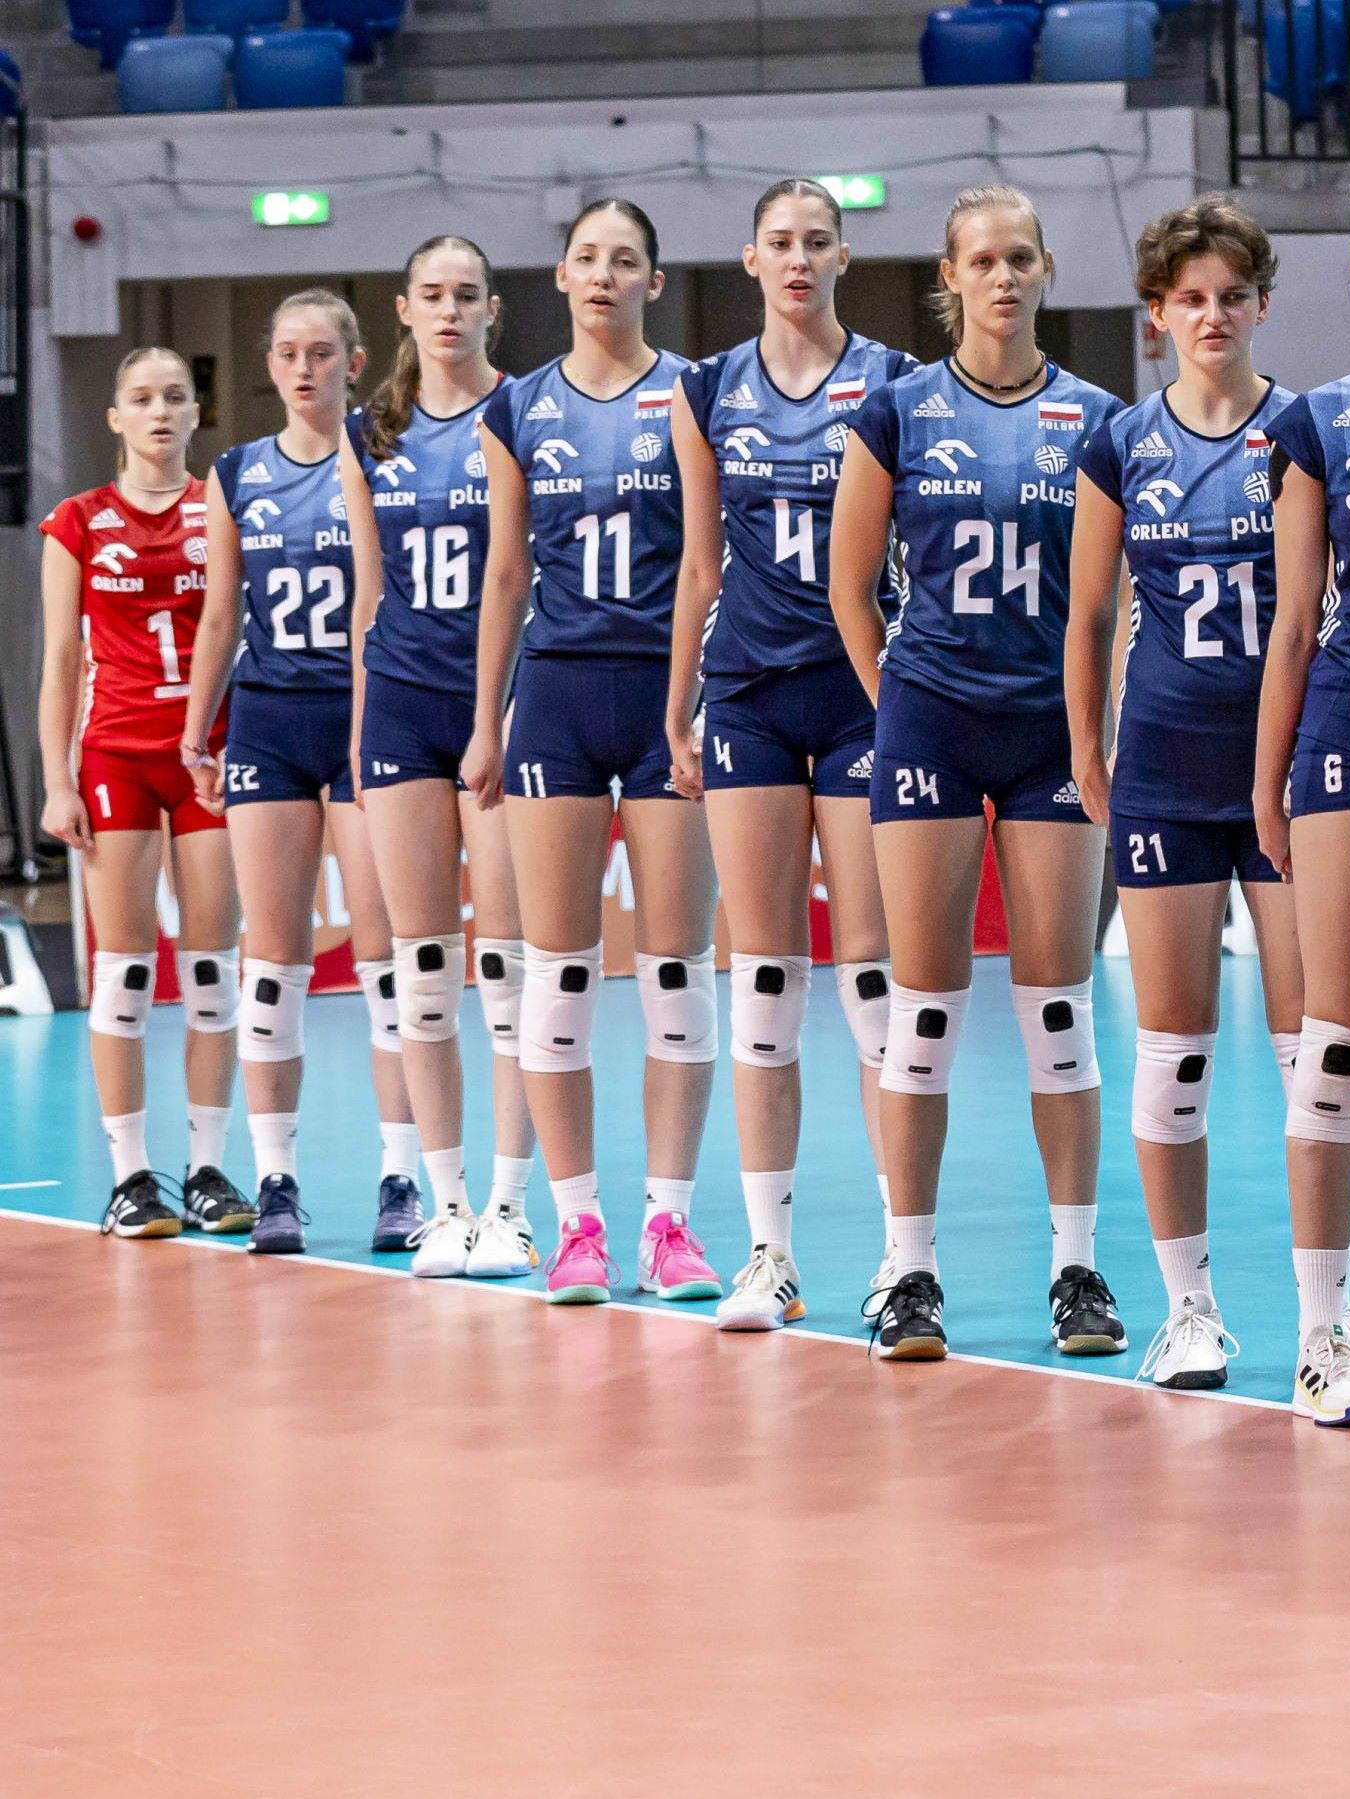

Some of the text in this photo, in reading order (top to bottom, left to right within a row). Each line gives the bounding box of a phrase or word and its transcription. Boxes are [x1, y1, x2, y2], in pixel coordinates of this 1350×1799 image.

[634, 409, 672, 420] POLSK
[1038, 421, 1084, 431] POLSKA
[617, 469, 672, 495] plus
[724, 463, 773, 477] ORLEN
[811, 459, 843, 485] pl
[450, 484, 490, 509] plu
[533, 478, 582, 495] ORLEN
[919, 480, 982, 496] ORLEN
[1020, 480, 1076, 507] plus
[314, 526, 352, 551] plu
[773, 498, 817, 582] 4
[1130, 522, 1189, 541] ORLEN
[1231, 511, 1275, 541] plu
[402, 525, 470, 609] 16
[574, 512, 631, 599] 11
[953, 520, 1041, 616] 24
[90, 574, 145, 593] ORLEN
[174, 570, 208, 595] plu
[266, 565, 348, 650] 22
[1178, 562, 1260, 659] 21
[147, 609, 182, 683] 1
[714, 735, 733, 774] 4
[226, 763, 261, 793] 22
[517, 761, 547, 799] 11
[895, 766, 940, 806] 24
[1323, 754, 1343, 793] 6
[94, 783, 113, 819] 1
[1129, 833, 1168, 873] 21
